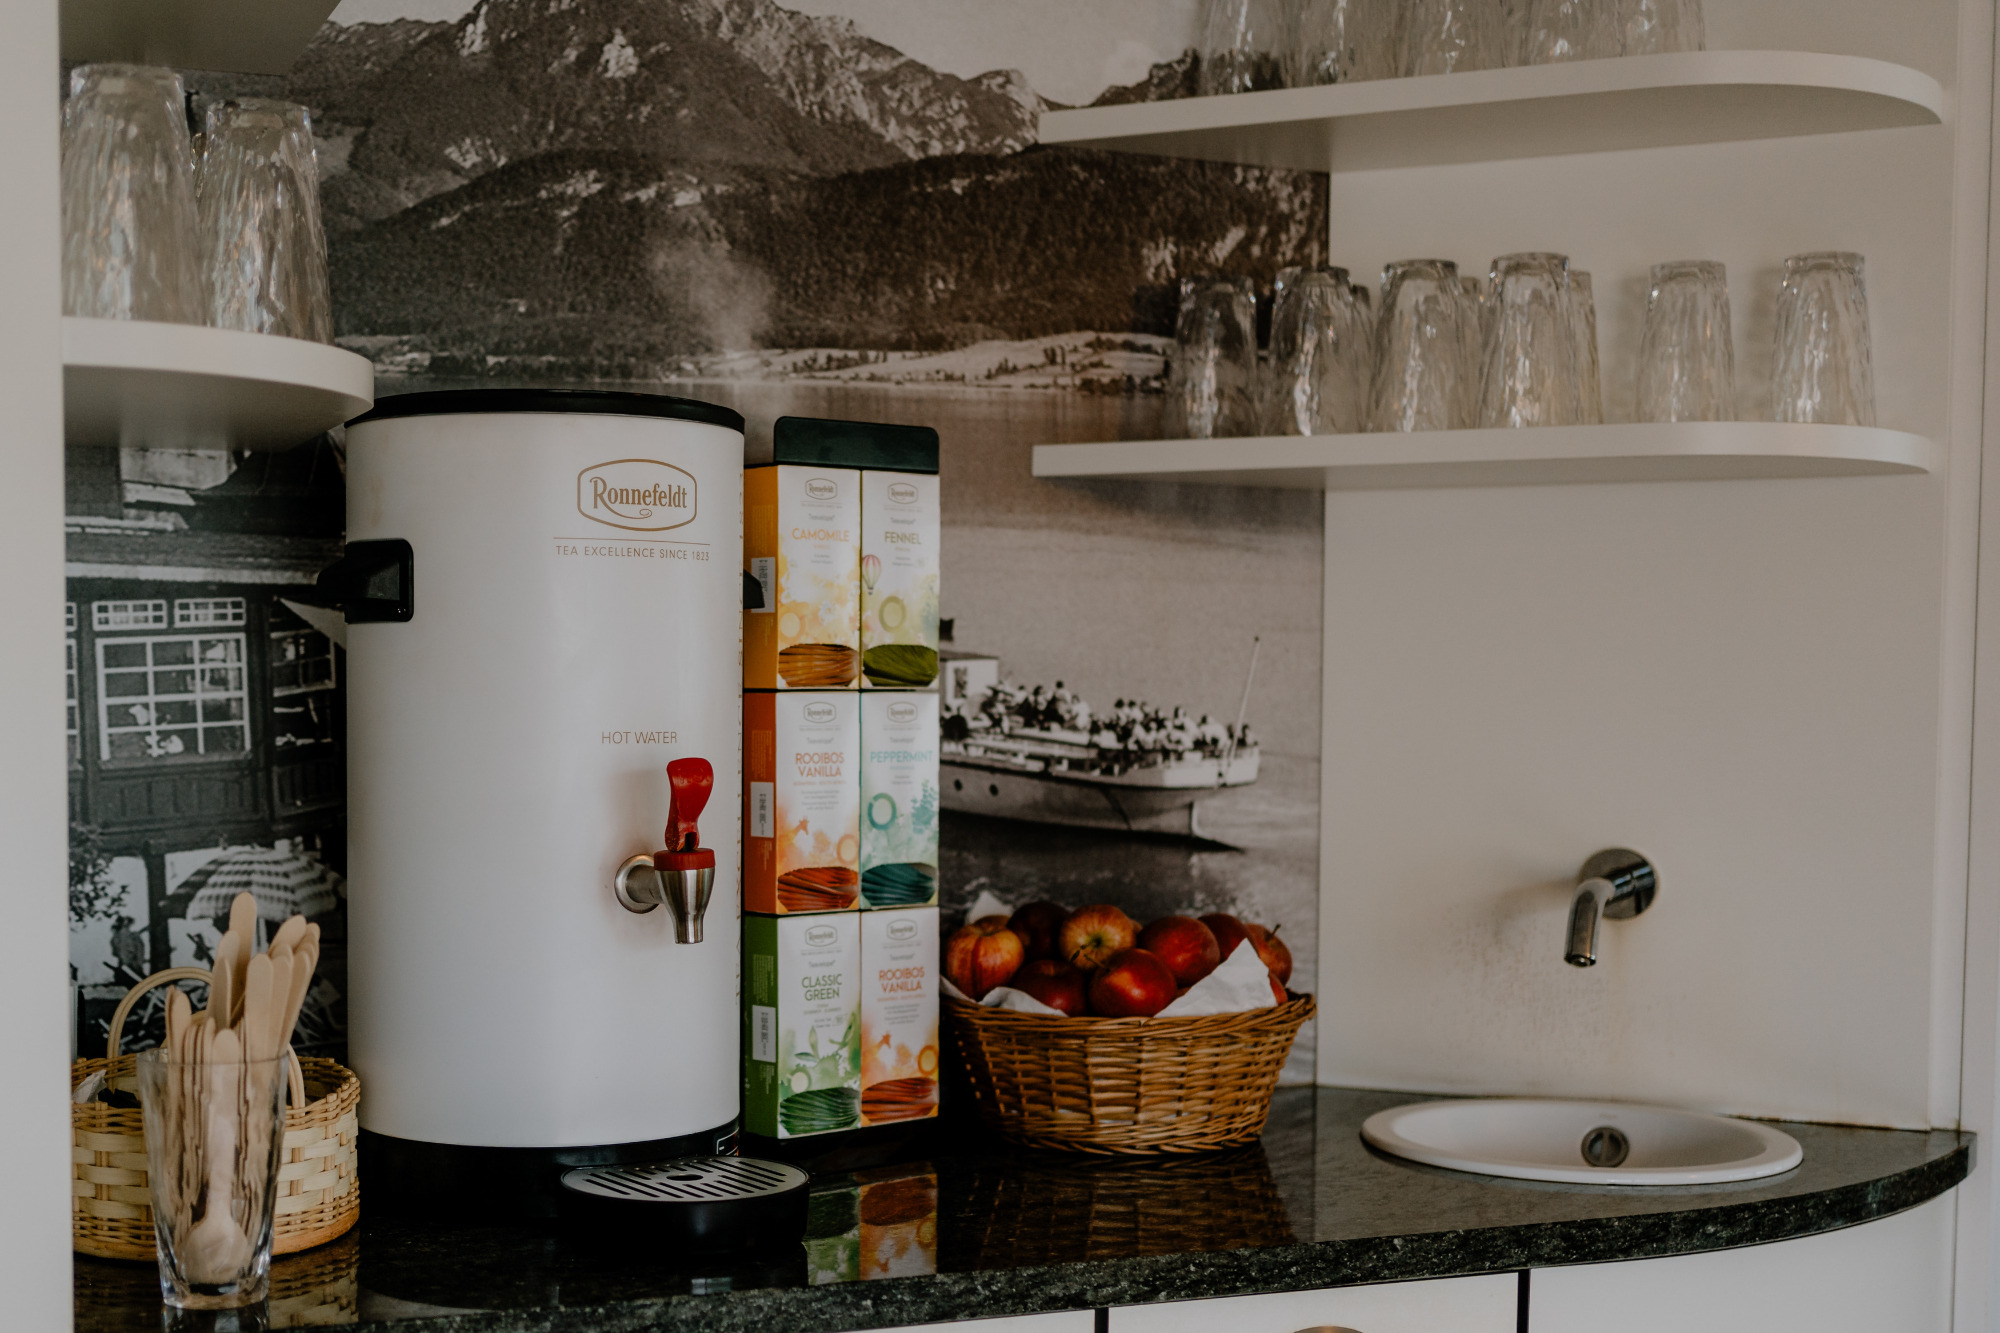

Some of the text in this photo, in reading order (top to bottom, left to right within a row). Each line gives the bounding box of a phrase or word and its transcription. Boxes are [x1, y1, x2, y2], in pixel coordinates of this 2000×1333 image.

[589, 476, 687, 519] Ronnefeldt
[791, 527, 849, 542] CAMOMILE
[884, 531, 922, 545] FENNEL
[556, 545, 710, 561] TEA EXCELLENCE SINCE 1823
[601, 731, 678, 744] HOT WATER
[795, 751, 845, 765] ROOIBOS
[869, 750, 933, 763] PEPPERMINT
[797, 765, 842, 777] VANILLA
[801, 973, 843, 989] CLASSIC
[878, 966, 925, 981] ROOIBOS
[804, 986, 840, 1001] GREEN
[881, 979, 923, 994] VANILLA
